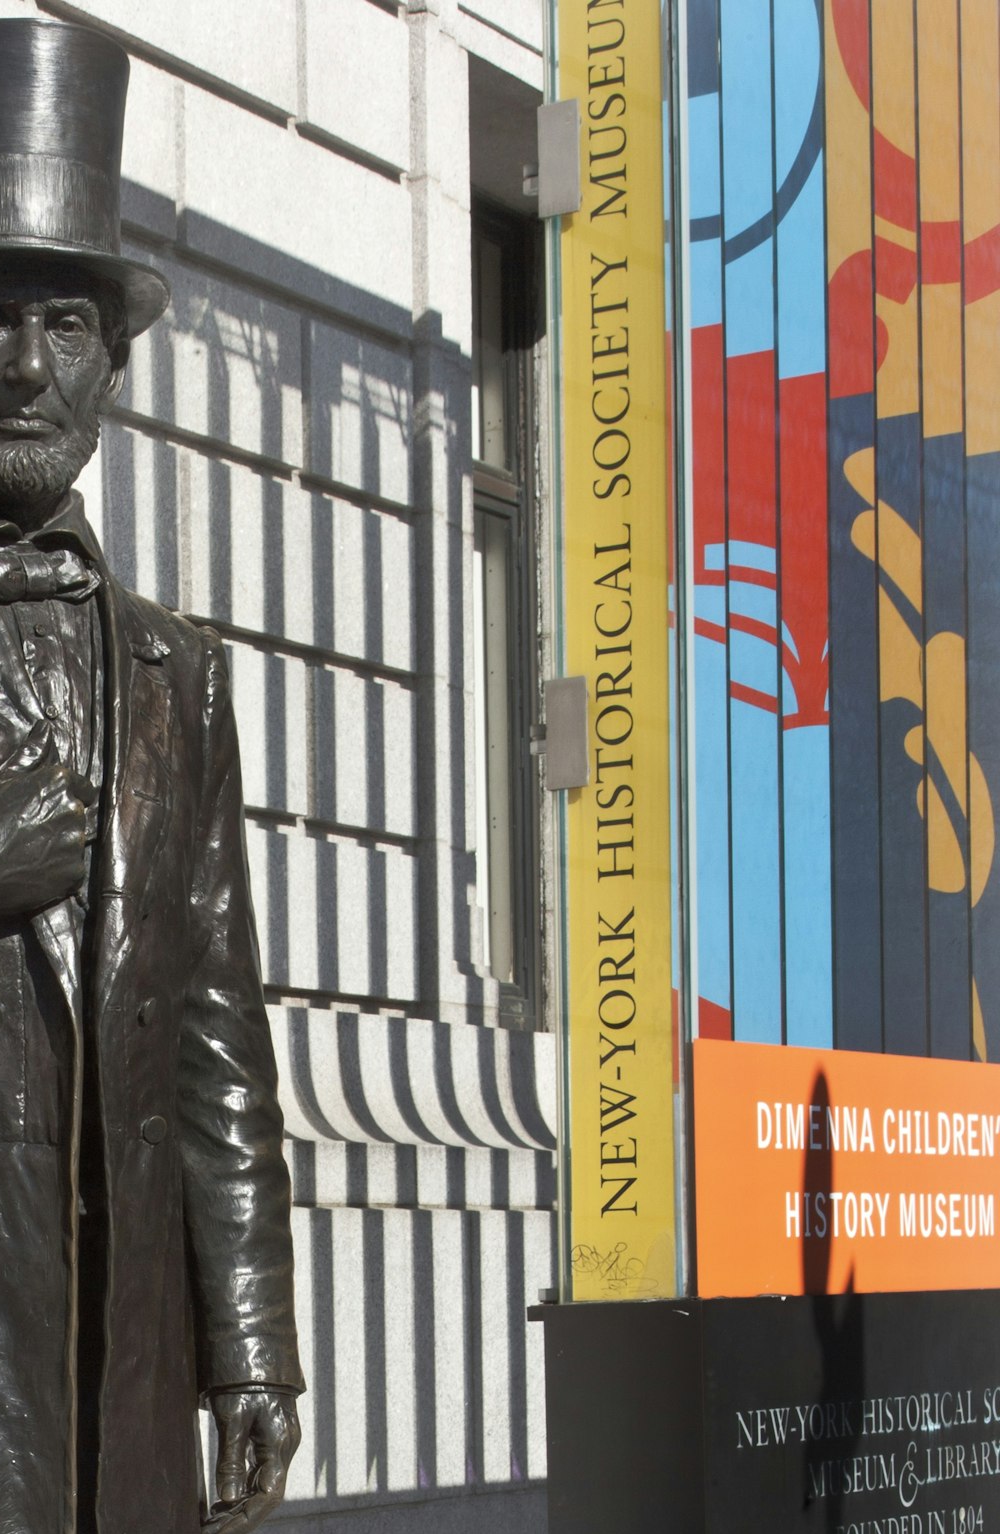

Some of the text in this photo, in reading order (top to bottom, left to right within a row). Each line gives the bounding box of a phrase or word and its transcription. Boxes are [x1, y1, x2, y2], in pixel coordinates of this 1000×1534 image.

[589, 252, 632, 499] SOCIETY
[593, 522, 636, 881] HISTORICAL
[597, 906, 638, 1219] NEW-YORK
[756, 1101, 875, 1152] DIMENNA
[785, 1192, 995, 1238] HISTORY MUSEUM
[735, 1402, 855, 1449] NEW-YORK
[861, 1390, 978, 1435] HISTORICAL
[808, 1439, 1000, 1508] MUSEUM & LIBRARY
